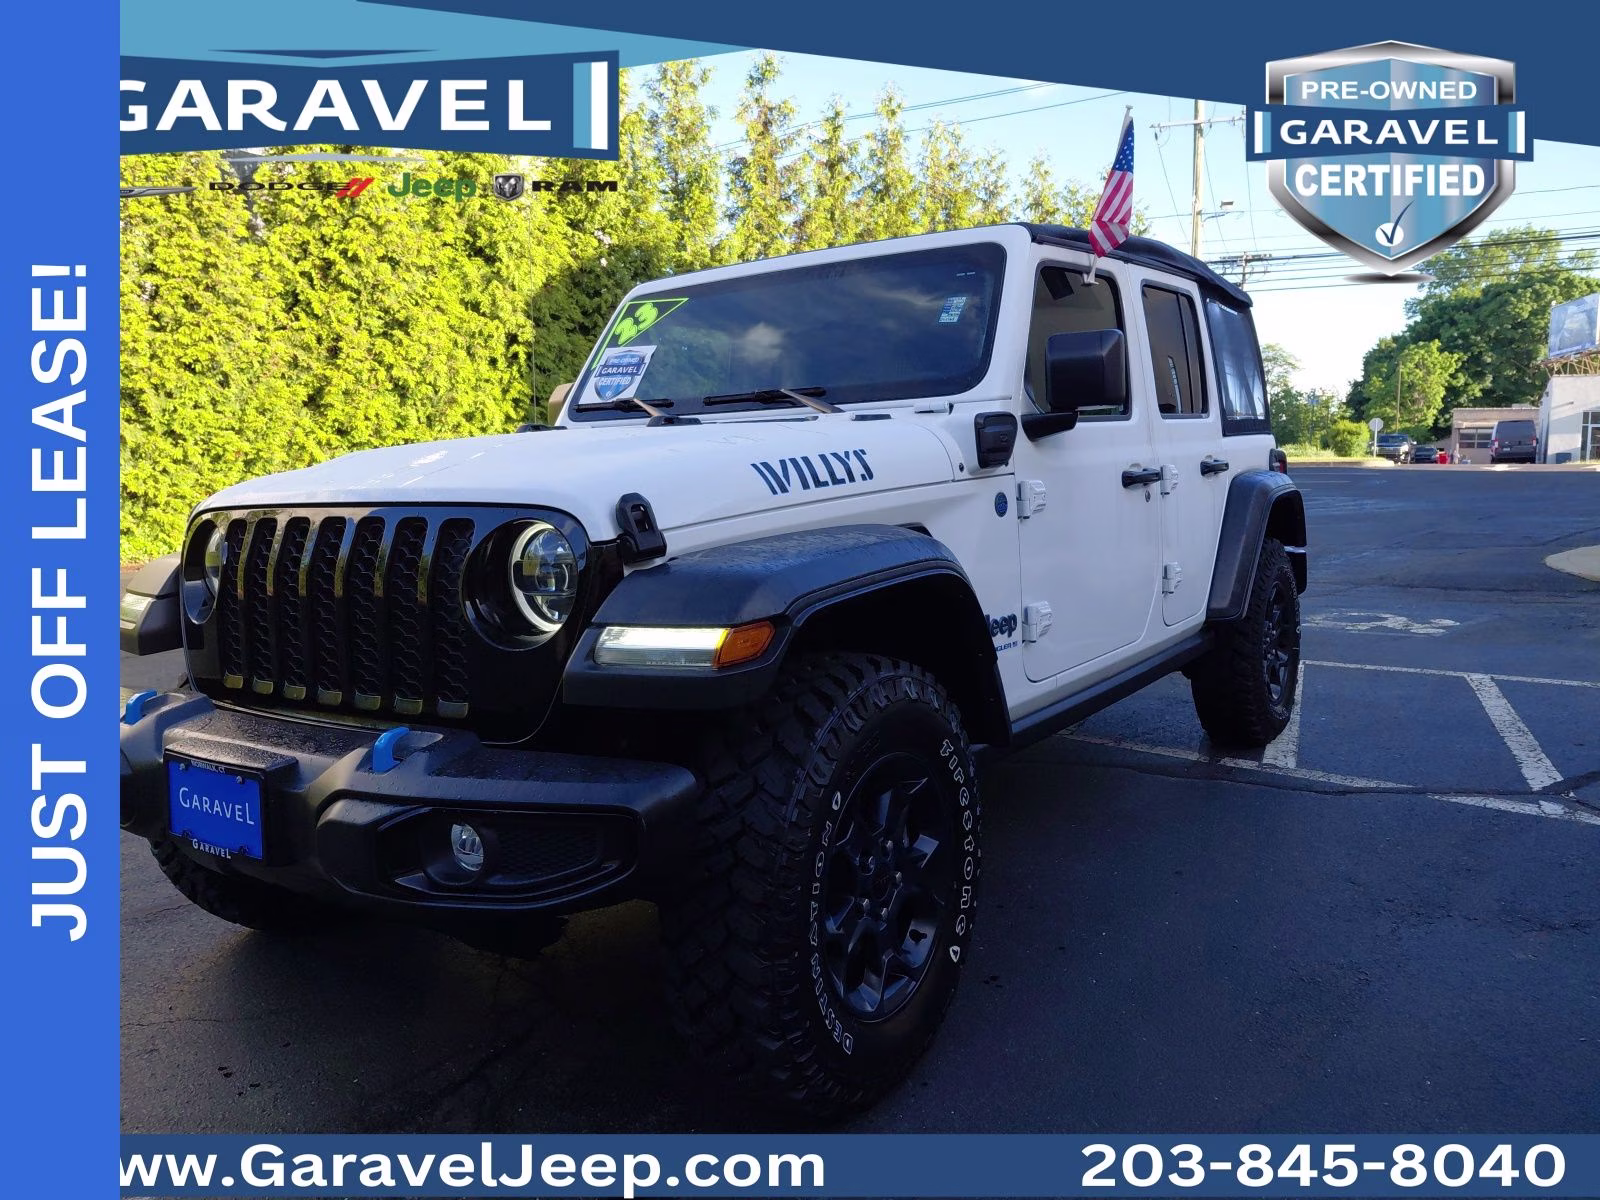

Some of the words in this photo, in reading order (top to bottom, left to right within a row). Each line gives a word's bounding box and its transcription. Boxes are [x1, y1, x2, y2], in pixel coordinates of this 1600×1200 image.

[615, 302, 659, 345] 23
[601, 366, 638, 374] GARAVEL
[750, 448, 874, 496] WILLYS
[179, 787, 255, 825] GARAVEL
[192, 838, 232, 860] GARAVEL
[809, 820, 854, 1055] DESTINATION
